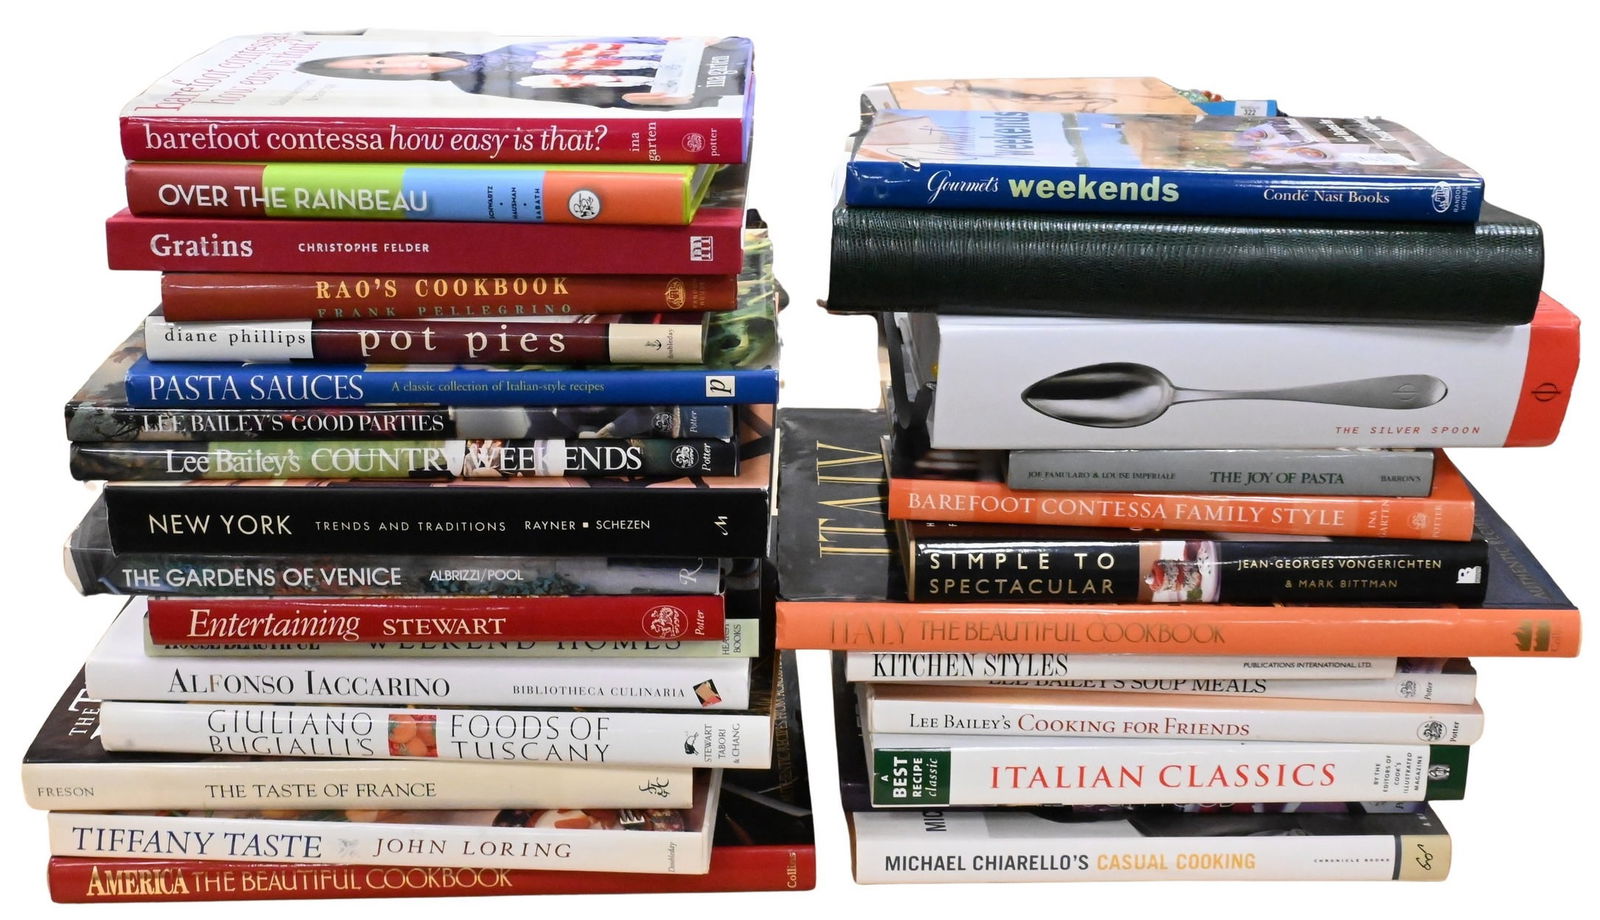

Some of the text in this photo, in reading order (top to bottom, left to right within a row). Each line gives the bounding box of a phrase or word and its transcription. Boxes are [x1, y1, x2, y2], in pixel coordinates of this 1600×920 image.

[145, 123, 608, 159] barefoot contessa how easy is that?
[629, 131, 640, 152] ina
[648, 121, 661, 161] garten
[711, 128, 720, 157] potter
[979, 111, 1036, 158] weekends
[158, 184, 428, 212] OVER THE RAINBEAU
[927, 169, 1391, 206] Gourmet's weekends Condé Nast Books
[534, 188, 542, 219] SABATH
[150, 233, 430, 257] Gratins CHRISTOPHE FELDER
[315, 277, 569, 299] RAO'S COOKBOOK
[317, 304, 571, 318] FRANK PELLEGRINO
[164, 323, 566, 358] diane phillips pot pies
[150, 374, 605, 402] PASTA SAUCES A classic collection of Italian-style recipes
[143, 413, 444, 433] LEE BAILEY'S GOOD PARTIES
[689, 410, 698, 433] Potter
[1335, 426, 1481, 435] THE SILVER SPOON
[166, 446, 643, 477] Lee Bailey's COUNTRY WEEKENDS
[701, 442, 712, 472] Potter
[1027, 471, 1422, 486] JOE FAMULARO & LOUISE IMPERIALE THE JOY OF PASTA BARRON'S
[908, 493, 1345, 526] BAREFOOT CONTESSA FAMILY STYLE
[1368, 510, 1378, 529] INA
[1379, 499, 1391, 537] GARTEN
[149, 514, 650, 535] NEW YORK TRENDS AND TRADITIONS RAYNER SCHEZEN
[929, 552, 1442, 571] SIMPLE TO JEAN-GEORGES VONGERICHTEN
[122, 567, 524, 588] THE GARDENS OF VENICE ALBRIZZI/POOL
[929, 578, 1398, 595] SPECTACULAR & MARK BITTMAN
[187, 609, 507, 641] Entertaining STEWART
[694, 609, 705, 636] Potter
[831, 614, 1226, 645] ITALY THE BEAUTIFUL COOKBOOK
[733, 624, 742, 653] BOOKS
[873, 653, 975, 677] KITCHEN
[983, 653, 1069, 677] STYLES
[1243, 661, 1296, 669] PUBLICATIONS
[168, 668, 686, 698] ALFONSO IACCARINO BIBLIOTHECA CULINARIA
[1191, 678, 1267, 694] MEALS
[1424, 681, 1433, 700] Potter
[68, 707, 101, 736] THE
[207, 708, 374, 736] GIULIANO
[450, 714, 610, 742] FOODS OF
[909, 713, 1250, 737] LEE BAILEY'S COOKING FOR FRIENDS
[1450, 720, 1460, 743] Potter
[208, 735, 374, 757] BUGIALLI'S
[450, 740, 610, 763] TUSCANY
[703, 723, 713, 763] STEWART
[717, 728, 727, 759] TABORI
[732, 722, 741, 757] CHANG
[881, 774, 889, 782] A
[893, 756, 908, 798] BEST
[912, 757, 923, 798] RECIPE
[925, 757, 938, 797] classic
[990, 763, 1336, 789] ITALIAN CLASSICS
[1413, 756, 1423, 791] MAGAZINE
[37, 782, 437, 799] FRESON THE TASTE OF FRANCE
[72, 826, 573, 859] TIFFANY TASTE JOHN LORING
[885, 853, 1256, 871] MICHAEL CHIARELLO'S CASUAL COOKING
[86, 865, 513, 896] AMERICA THE BEAUTIFUL COOKBOOK
